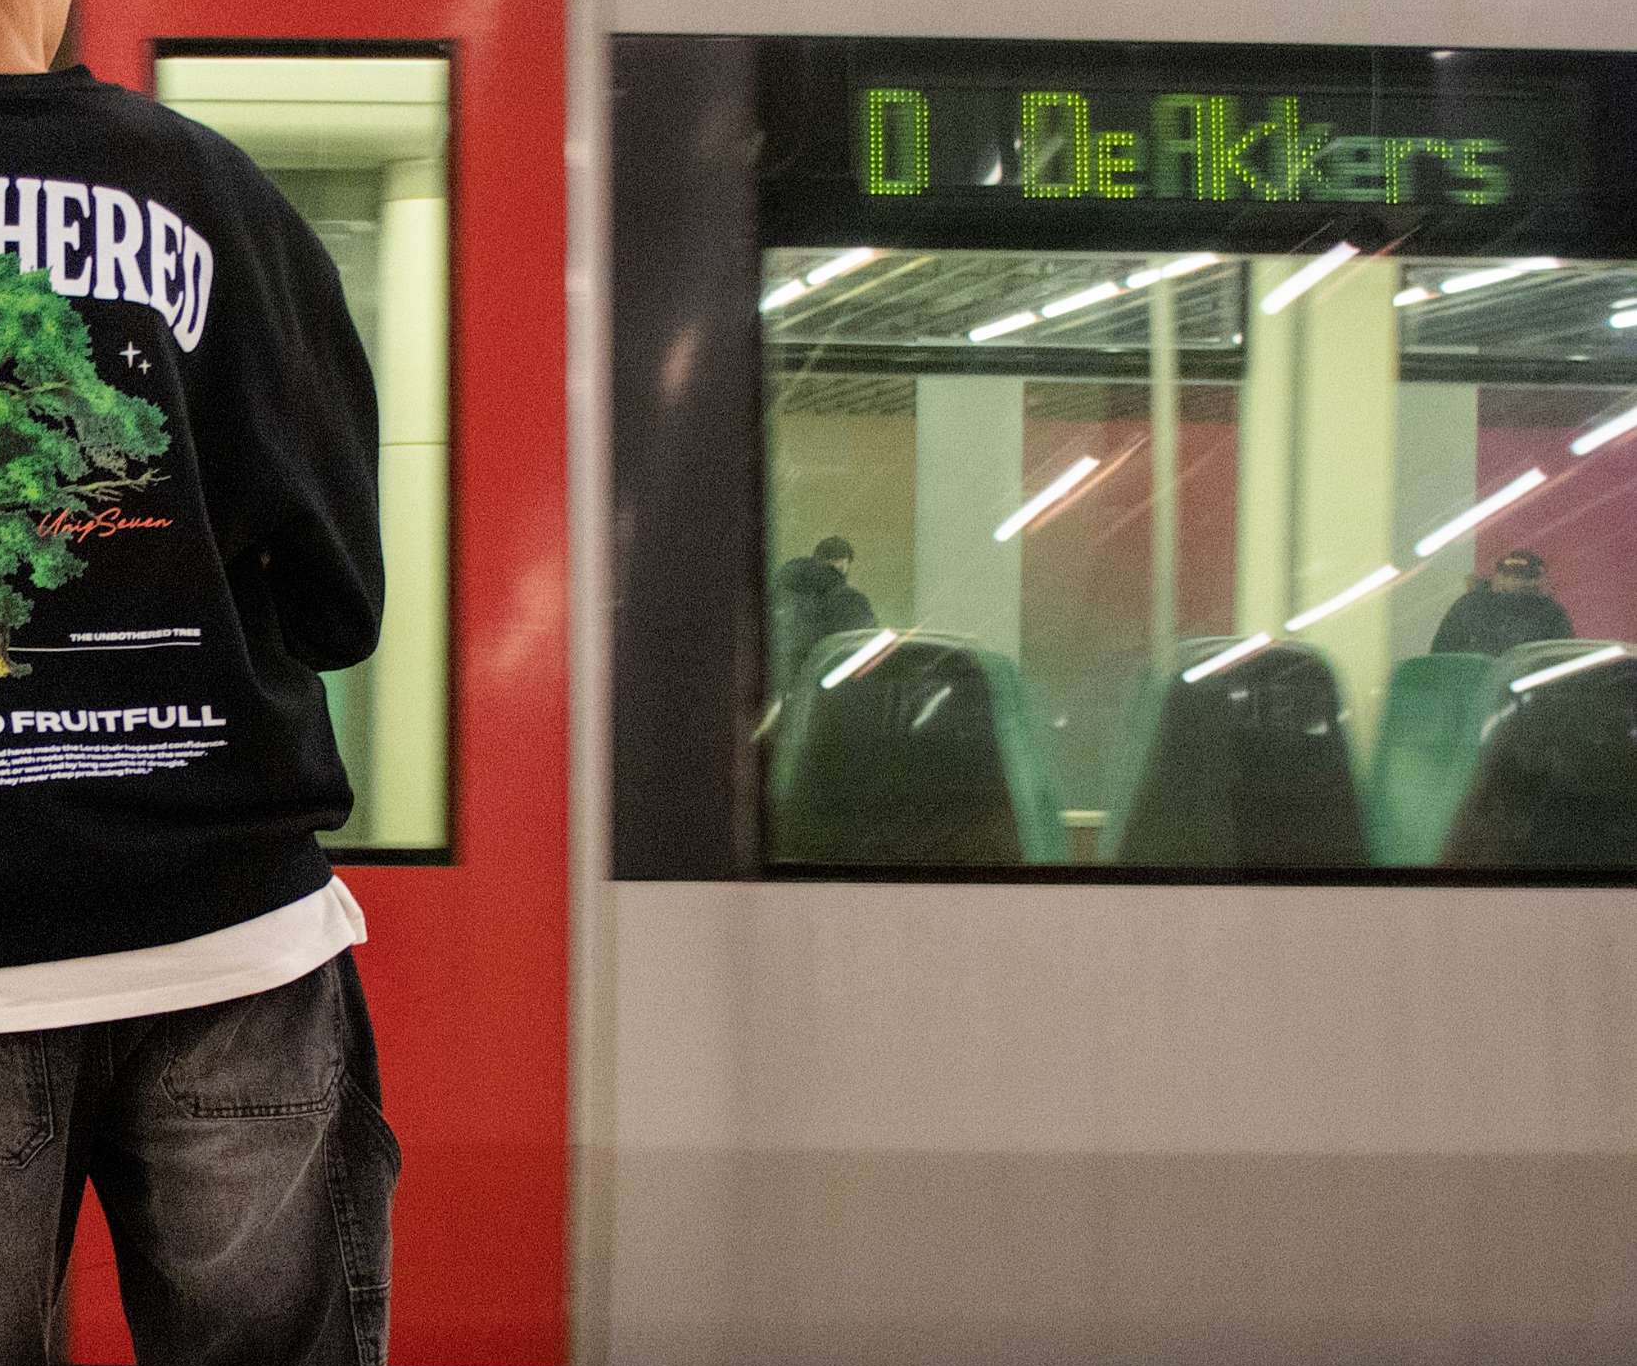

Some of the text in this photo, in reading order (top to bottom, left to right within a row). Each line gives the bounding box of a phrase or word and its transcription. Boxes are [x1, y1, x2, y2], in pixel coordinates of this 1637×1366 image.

[69, 627, 201, 642] THE UNBOTHERED TREE
[11, 705, 227, 733] FRUITFULL
